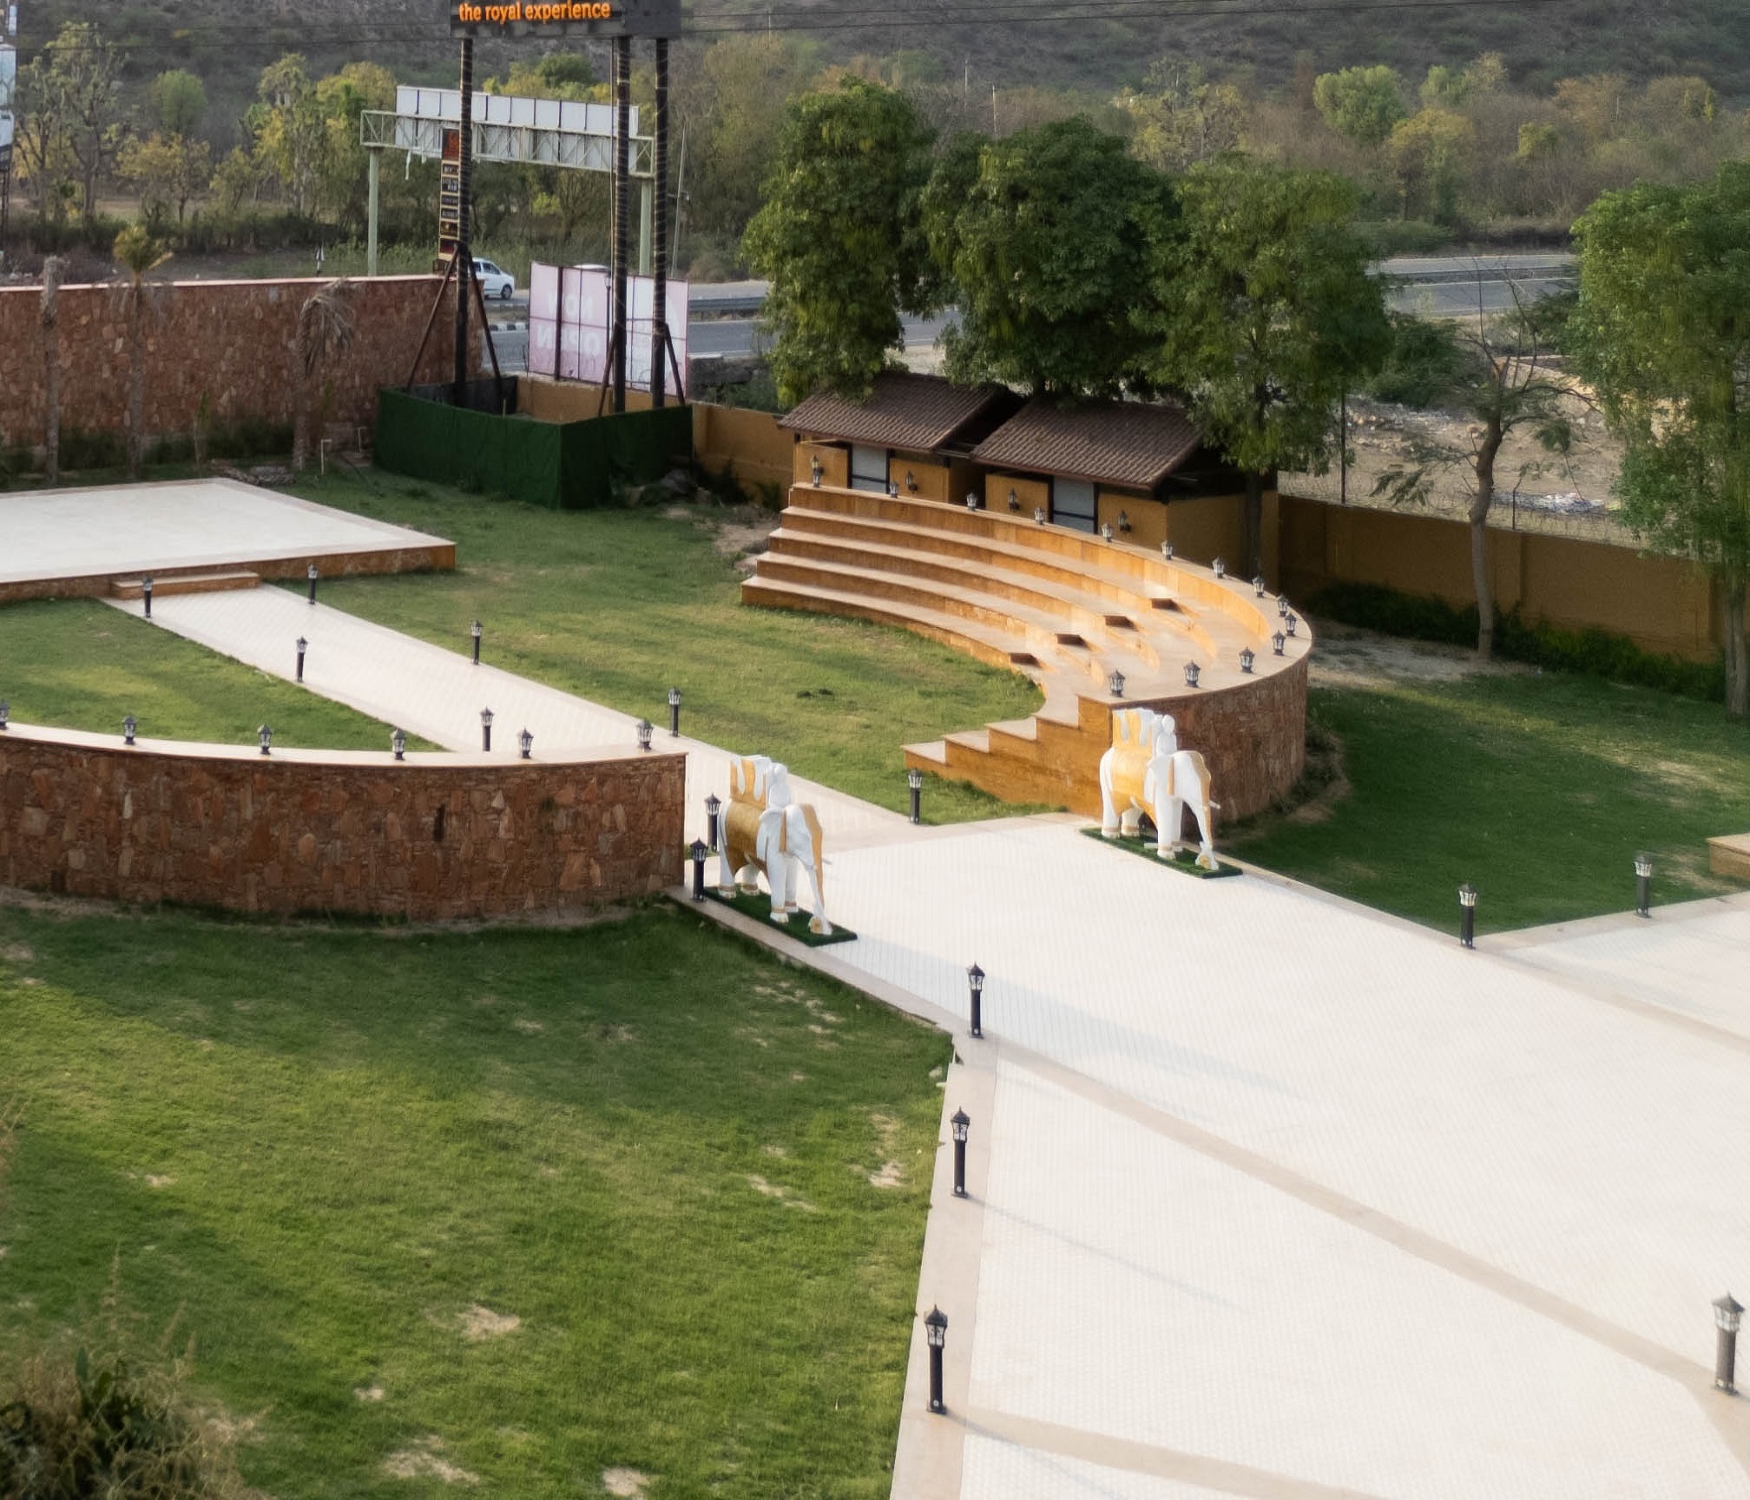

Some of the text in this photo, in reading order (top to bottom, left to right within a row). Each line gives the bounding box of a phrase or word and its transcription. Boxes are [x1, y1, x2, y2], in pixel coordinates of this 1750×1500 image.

[458, 0, 611, 25] the royal experience
